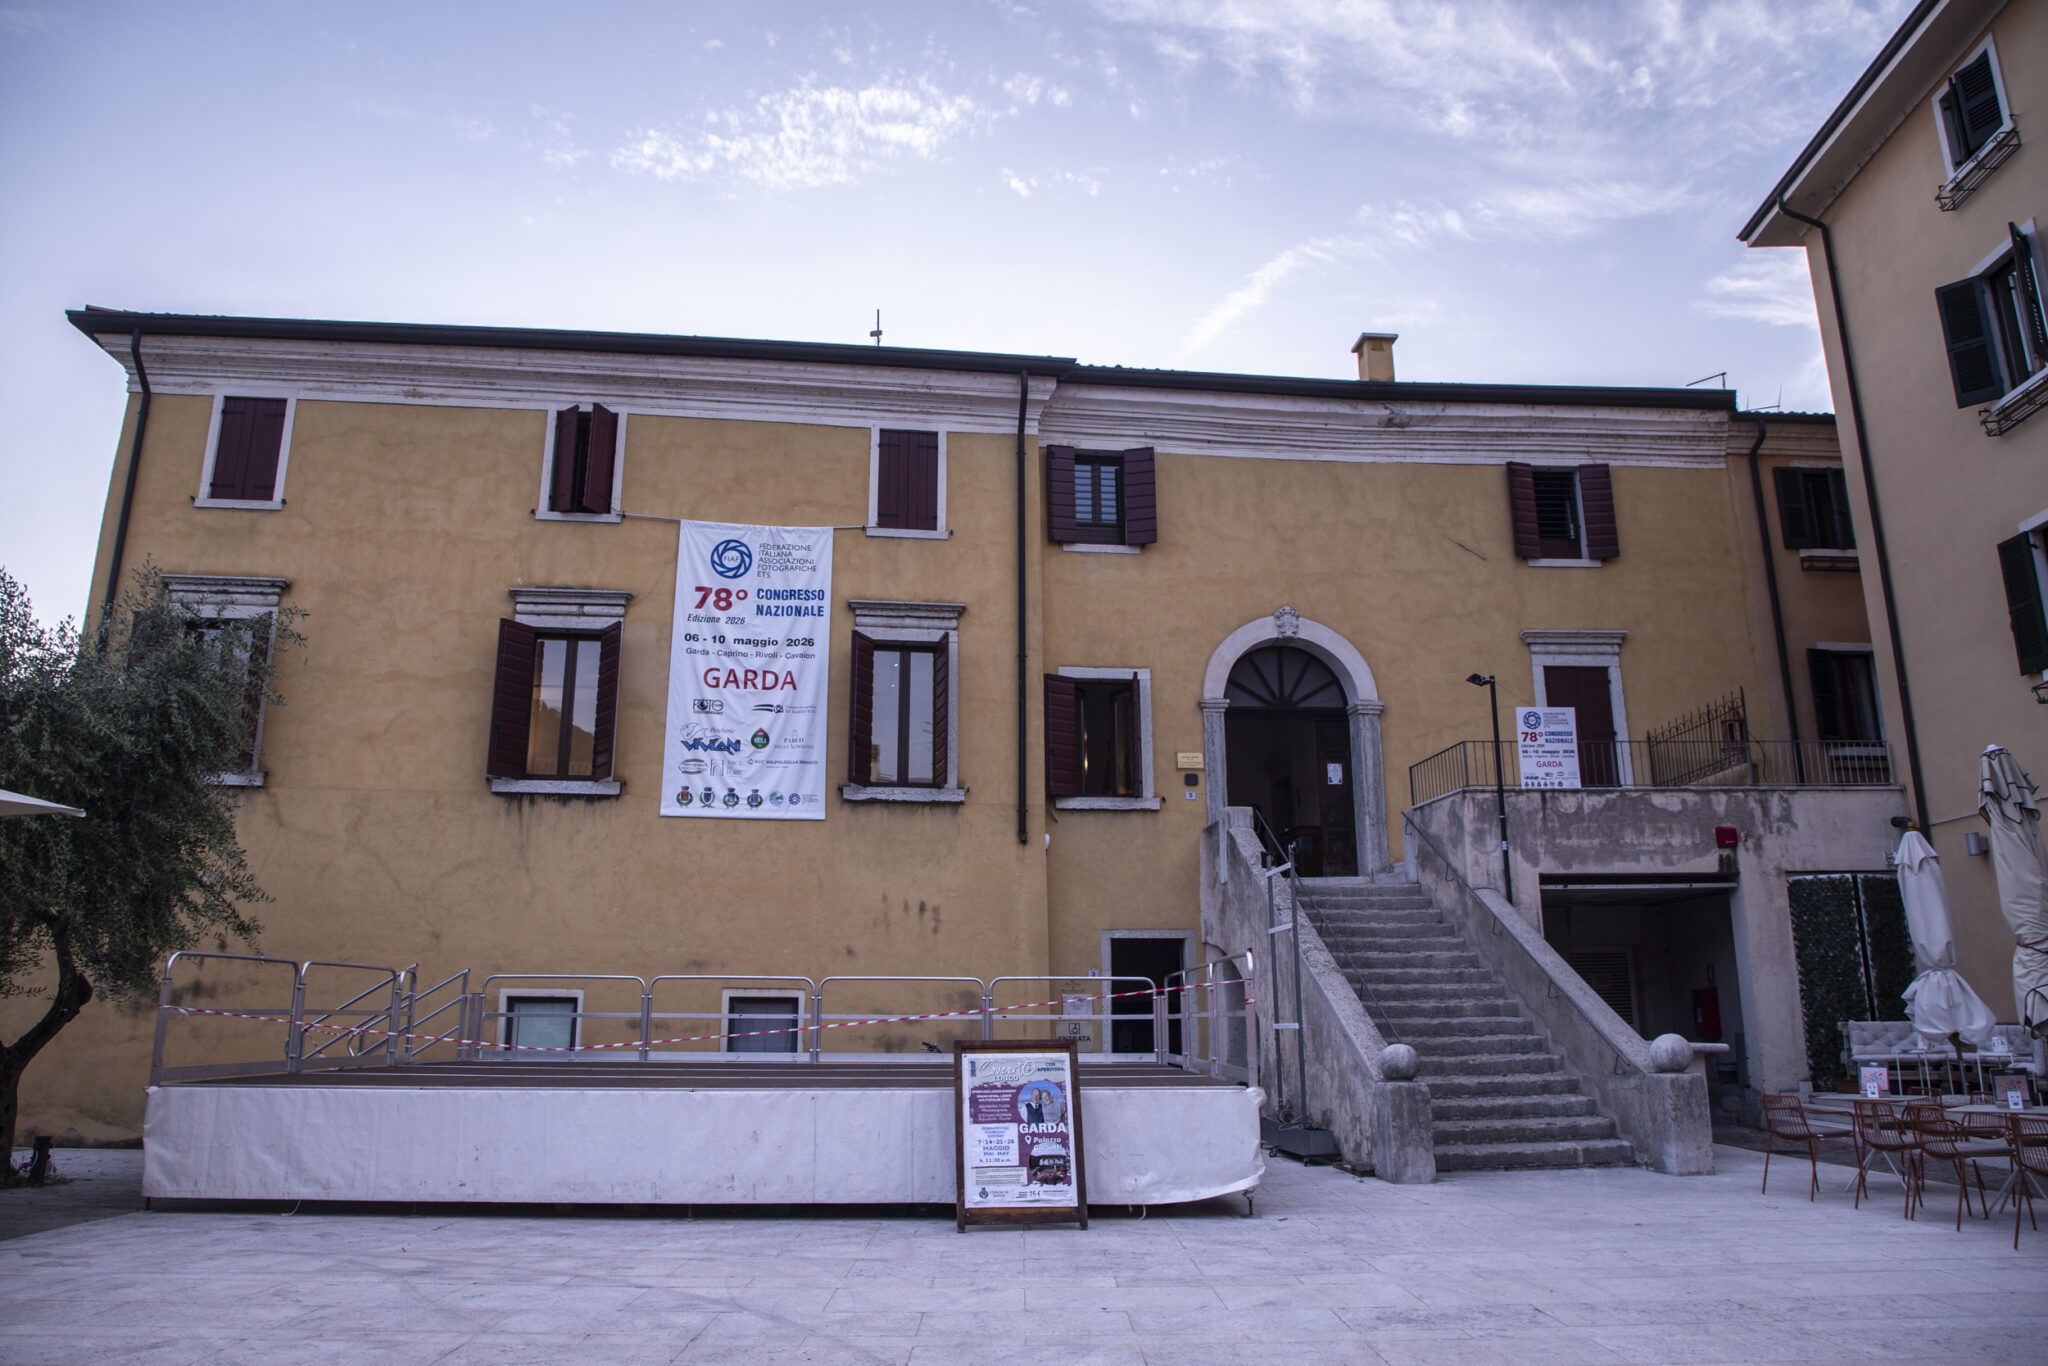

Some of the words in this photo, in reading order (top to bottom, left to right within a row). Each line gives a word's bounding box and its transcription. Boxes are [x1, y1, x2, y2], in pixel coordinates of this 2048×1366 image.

[759, 543, 812, 551] FEDERAZIONE
[758, 557, 815, 565] ASSOCIAZIONI
[757, 564, 817, 572] FOTOGRAFICHE
[694, 586, 748, 611] 78°
[757, 588, 825, 601] CONGRESSO
[756, 604, 825, 617] NAZIONALE
[687, 613, 721, 623] Edizione
[725, 616, 746, 625] 2026
[684, 633, 699, 642] 06
[711, 635, 726, 644] 10
[733, 637, 779, 648] maggio
[786, 637, 815, 647] 2026
[686, 647, 709, 656] Garda
[717, 649, 748, 659] Caprino
[755, 651, 778, 659] Rivoli
[703, 667, 797, 691] GARDA
[1019, 1122, 1067, 1134] GARDA
[1033, 1136, 1062, 1144] Palazzo
